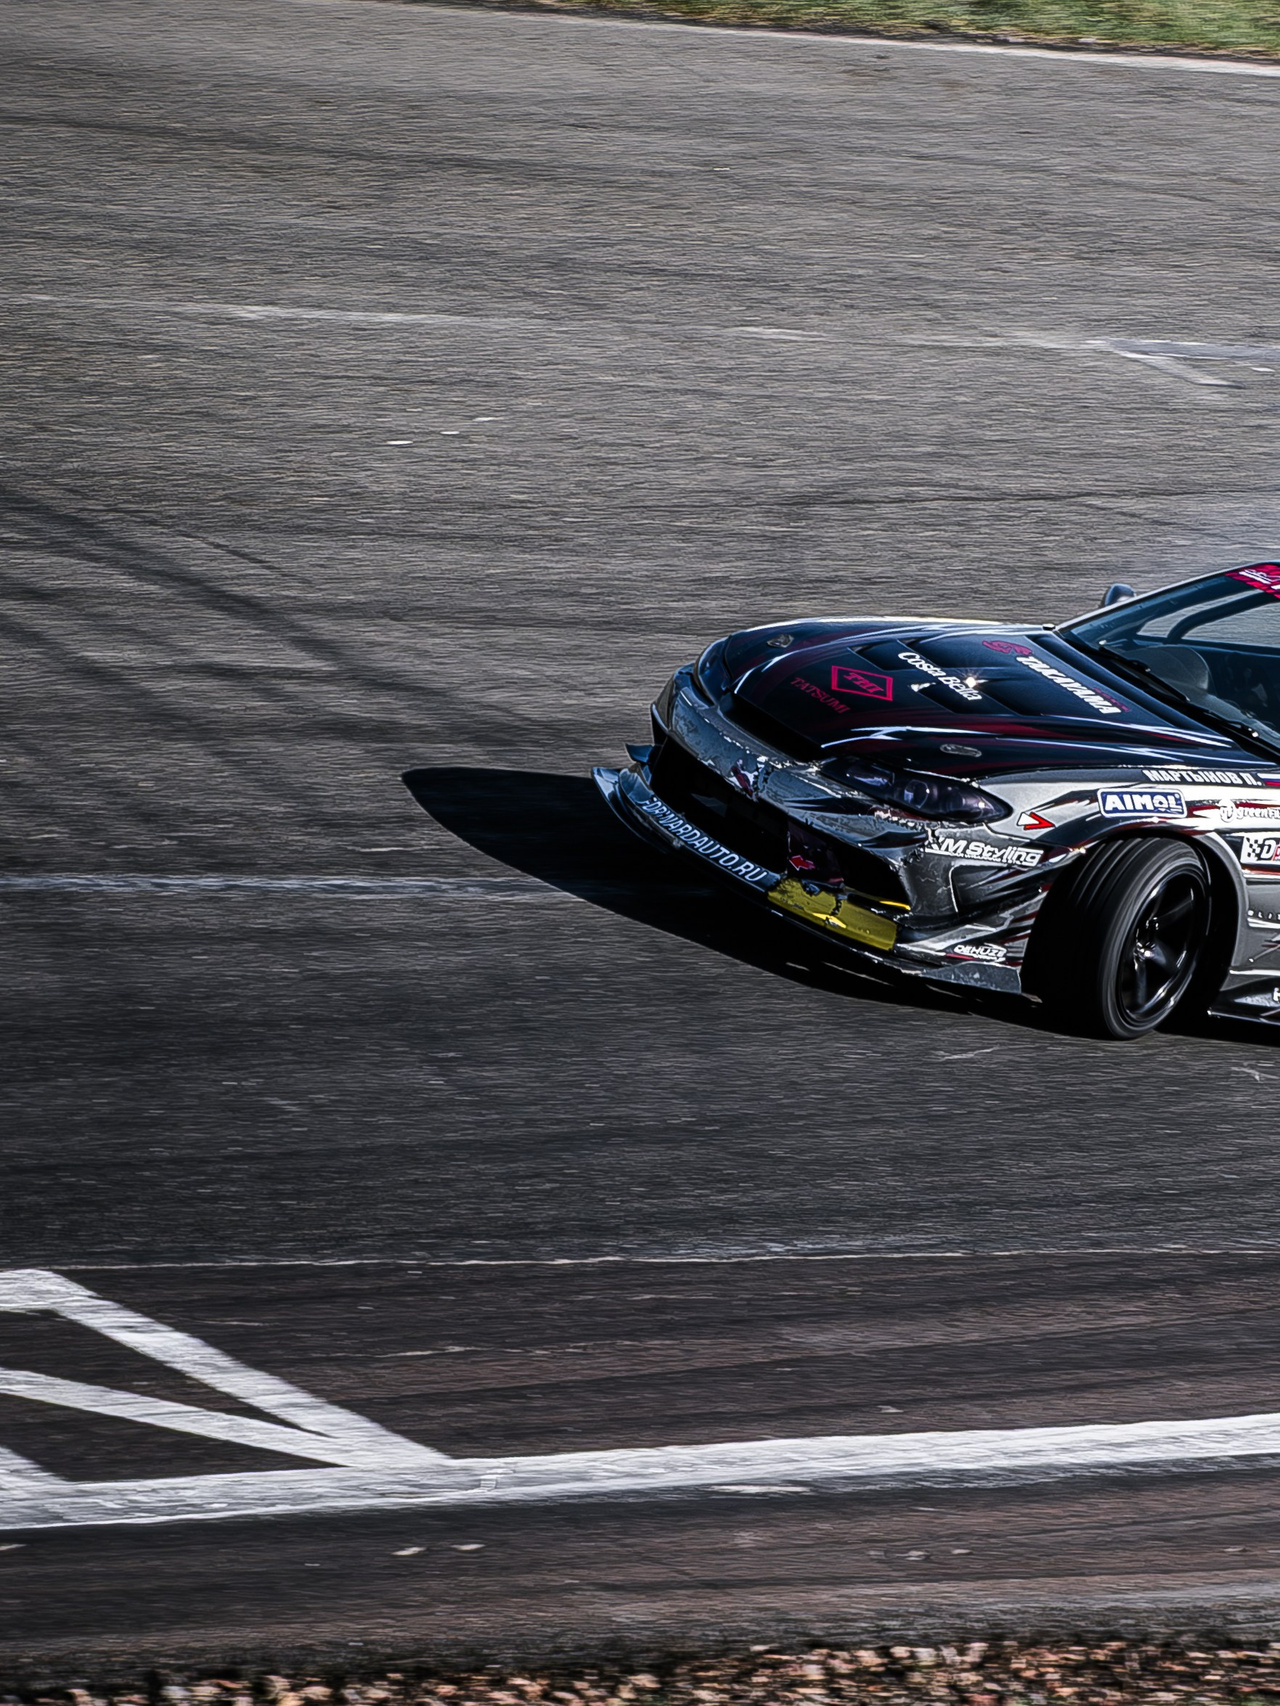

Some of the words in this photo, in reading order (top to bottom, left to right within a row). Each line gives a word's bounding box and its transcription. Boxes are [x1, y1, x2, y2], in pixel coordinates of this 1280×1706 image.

[898, 652, 945, 677] Costa
[938, 676, 982, 701] Bella
[1016, 655, 1122, 715] TAKAYAMA
[790, 677, 851, 714] TATSUMI
[1142, 769, 1242, 785] МАРТЫНОВ
[1104, 793, 1183, 813] AIMOL
[965, 841, 1045, 867] Styling
